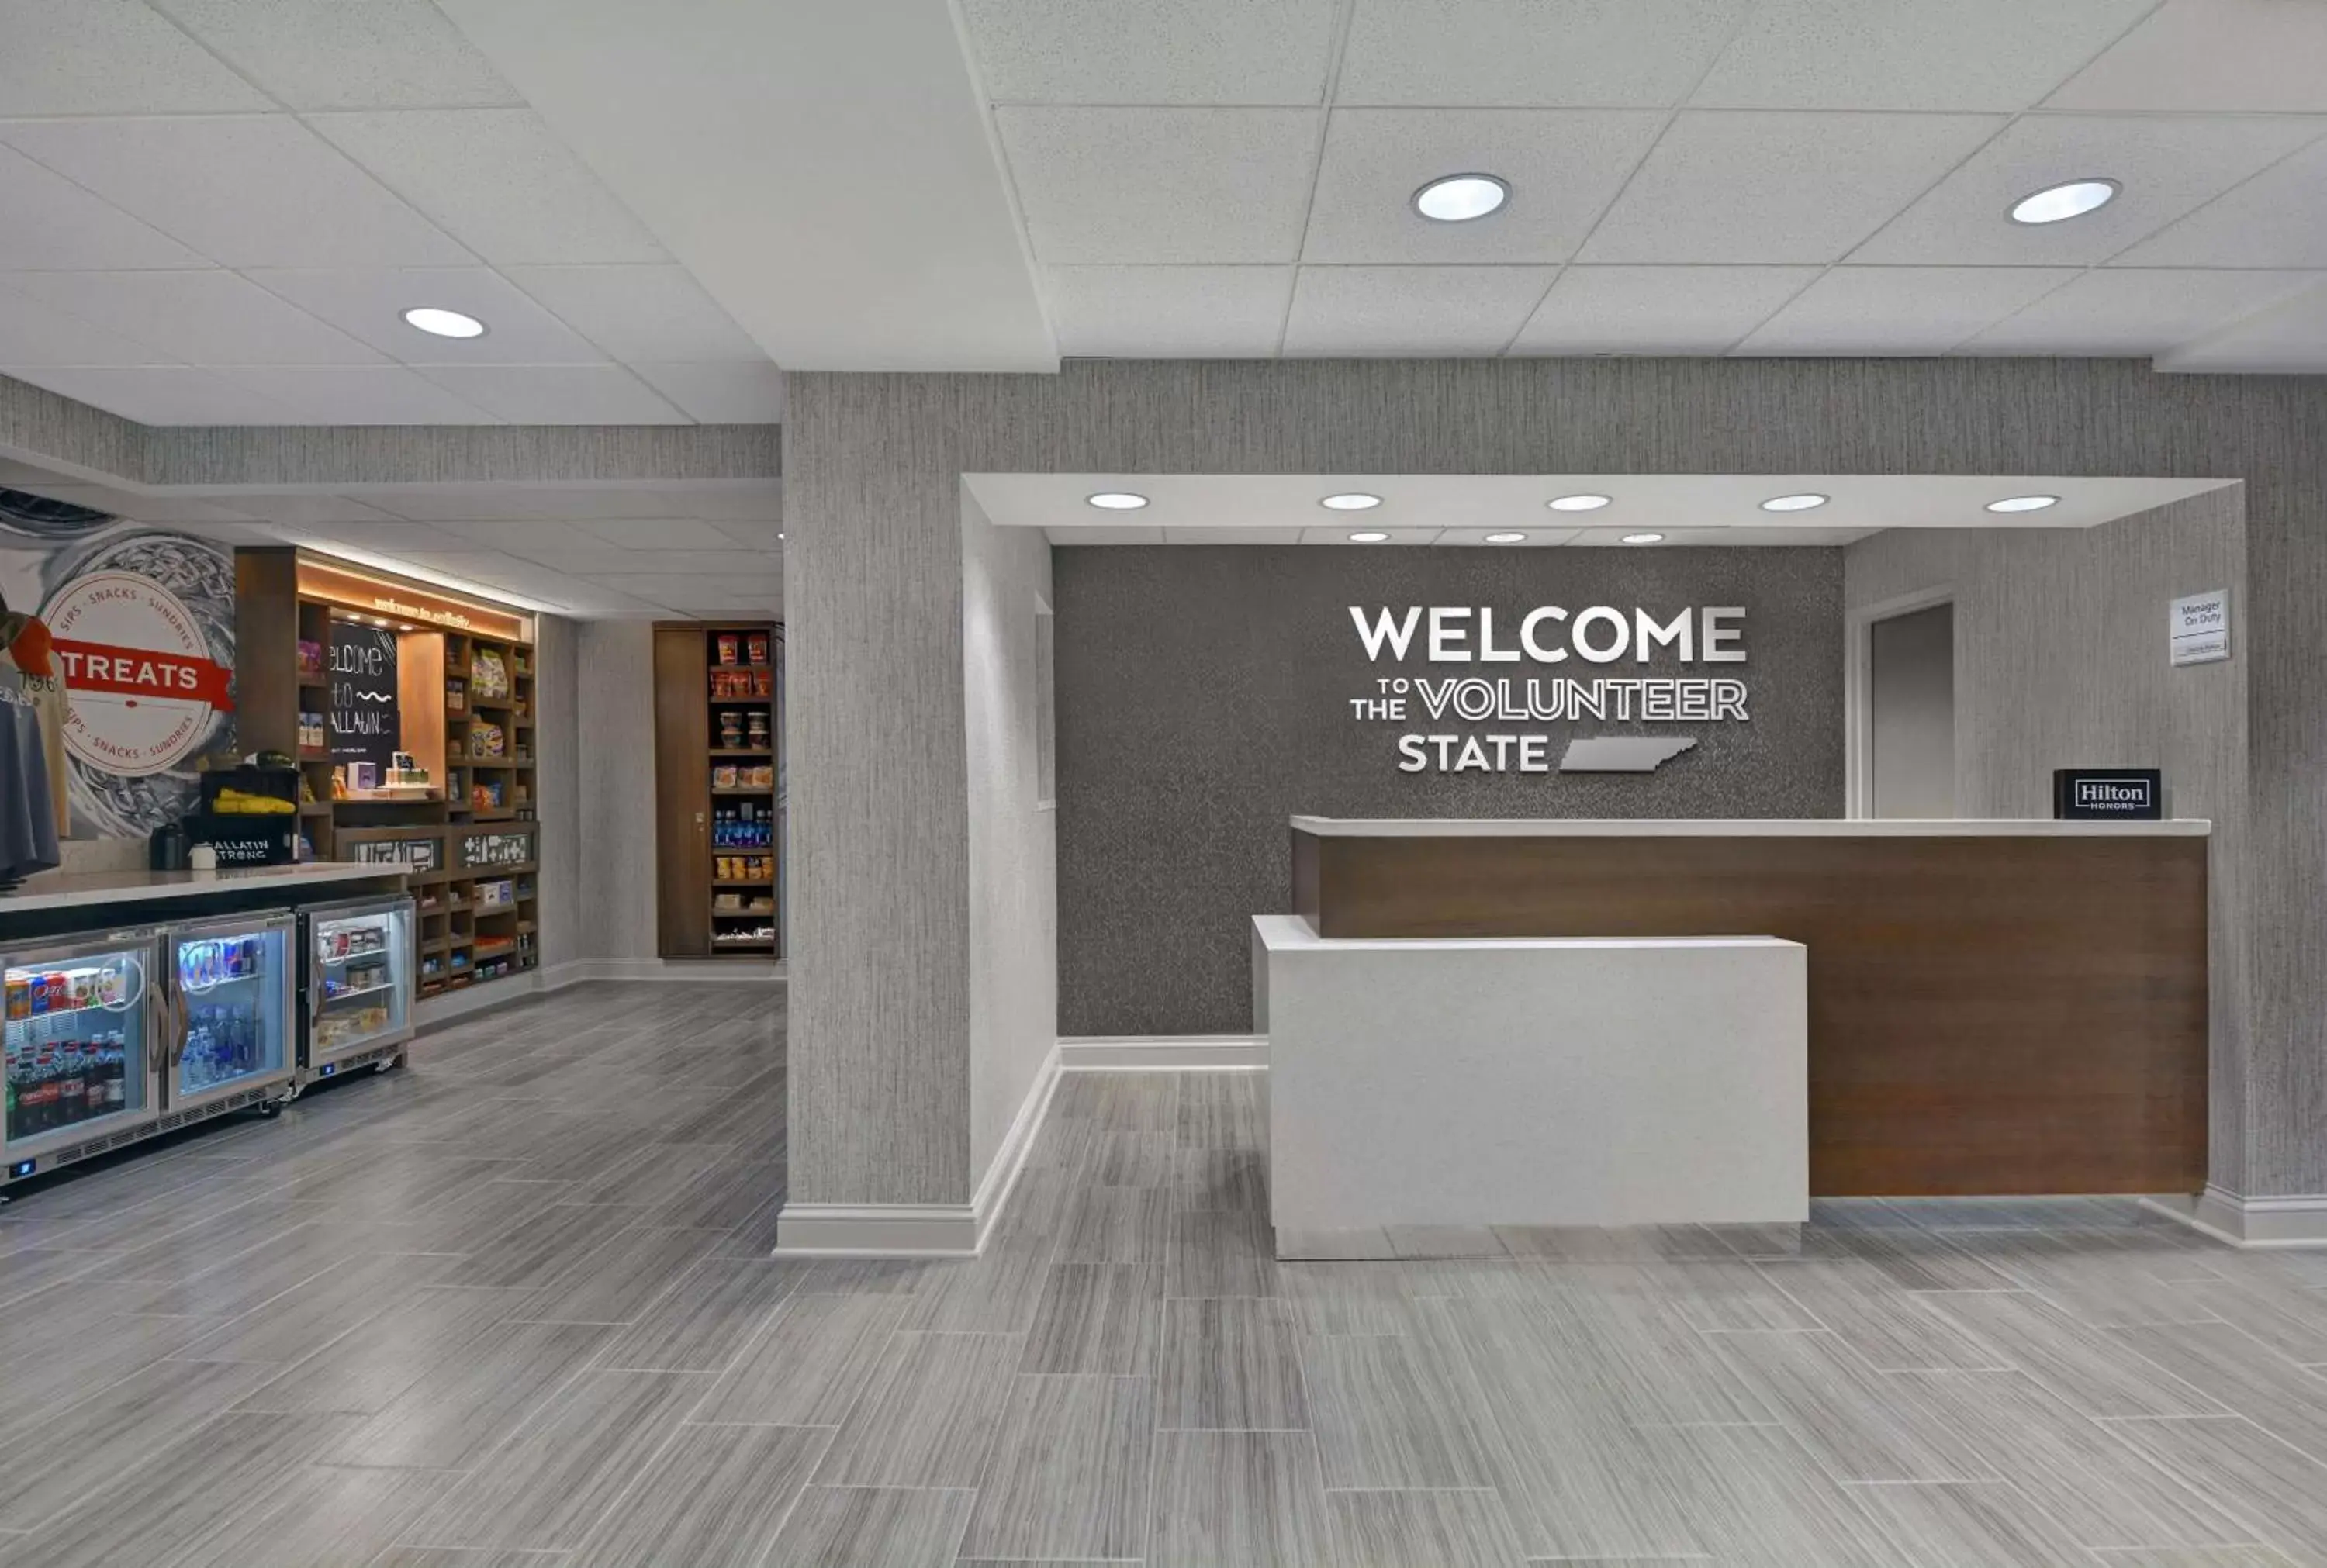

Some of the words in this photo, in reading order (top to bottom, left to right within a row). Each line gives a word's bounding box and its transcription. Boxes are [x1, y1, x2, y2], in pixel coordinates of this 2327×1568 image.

[2181, 602, 2221, 615] Manager
[60, 605, 82, 631] SIPS
[88, 587, 137, 605] SNACKS
[148, 597, 194, 650] SUNDRIES
[2184, 616, 2197, 626] On
[2199, 613, 2221, 623] Duty
[1348, 606, 1747, 662] WELCOME
[61, 651, 198, 689] TREATS
[1378, 678, 1409, 693] TO
[1350, 699, 1406, 720] THE
[1414, 679, 1749, 721] VOLUNTEER
[94, 737, 140, 758] SNACKS
[149, 716, 193, 756] SUNDRIES
[1398, 734, 1549, 772] STATE
[2081, 784, 2143, 801] Hilton
[2090, 802, 2135, 810] HONORS
[212, 840, 269, 851] ALLATIN
[217, 851, 267, 860] TRONG
